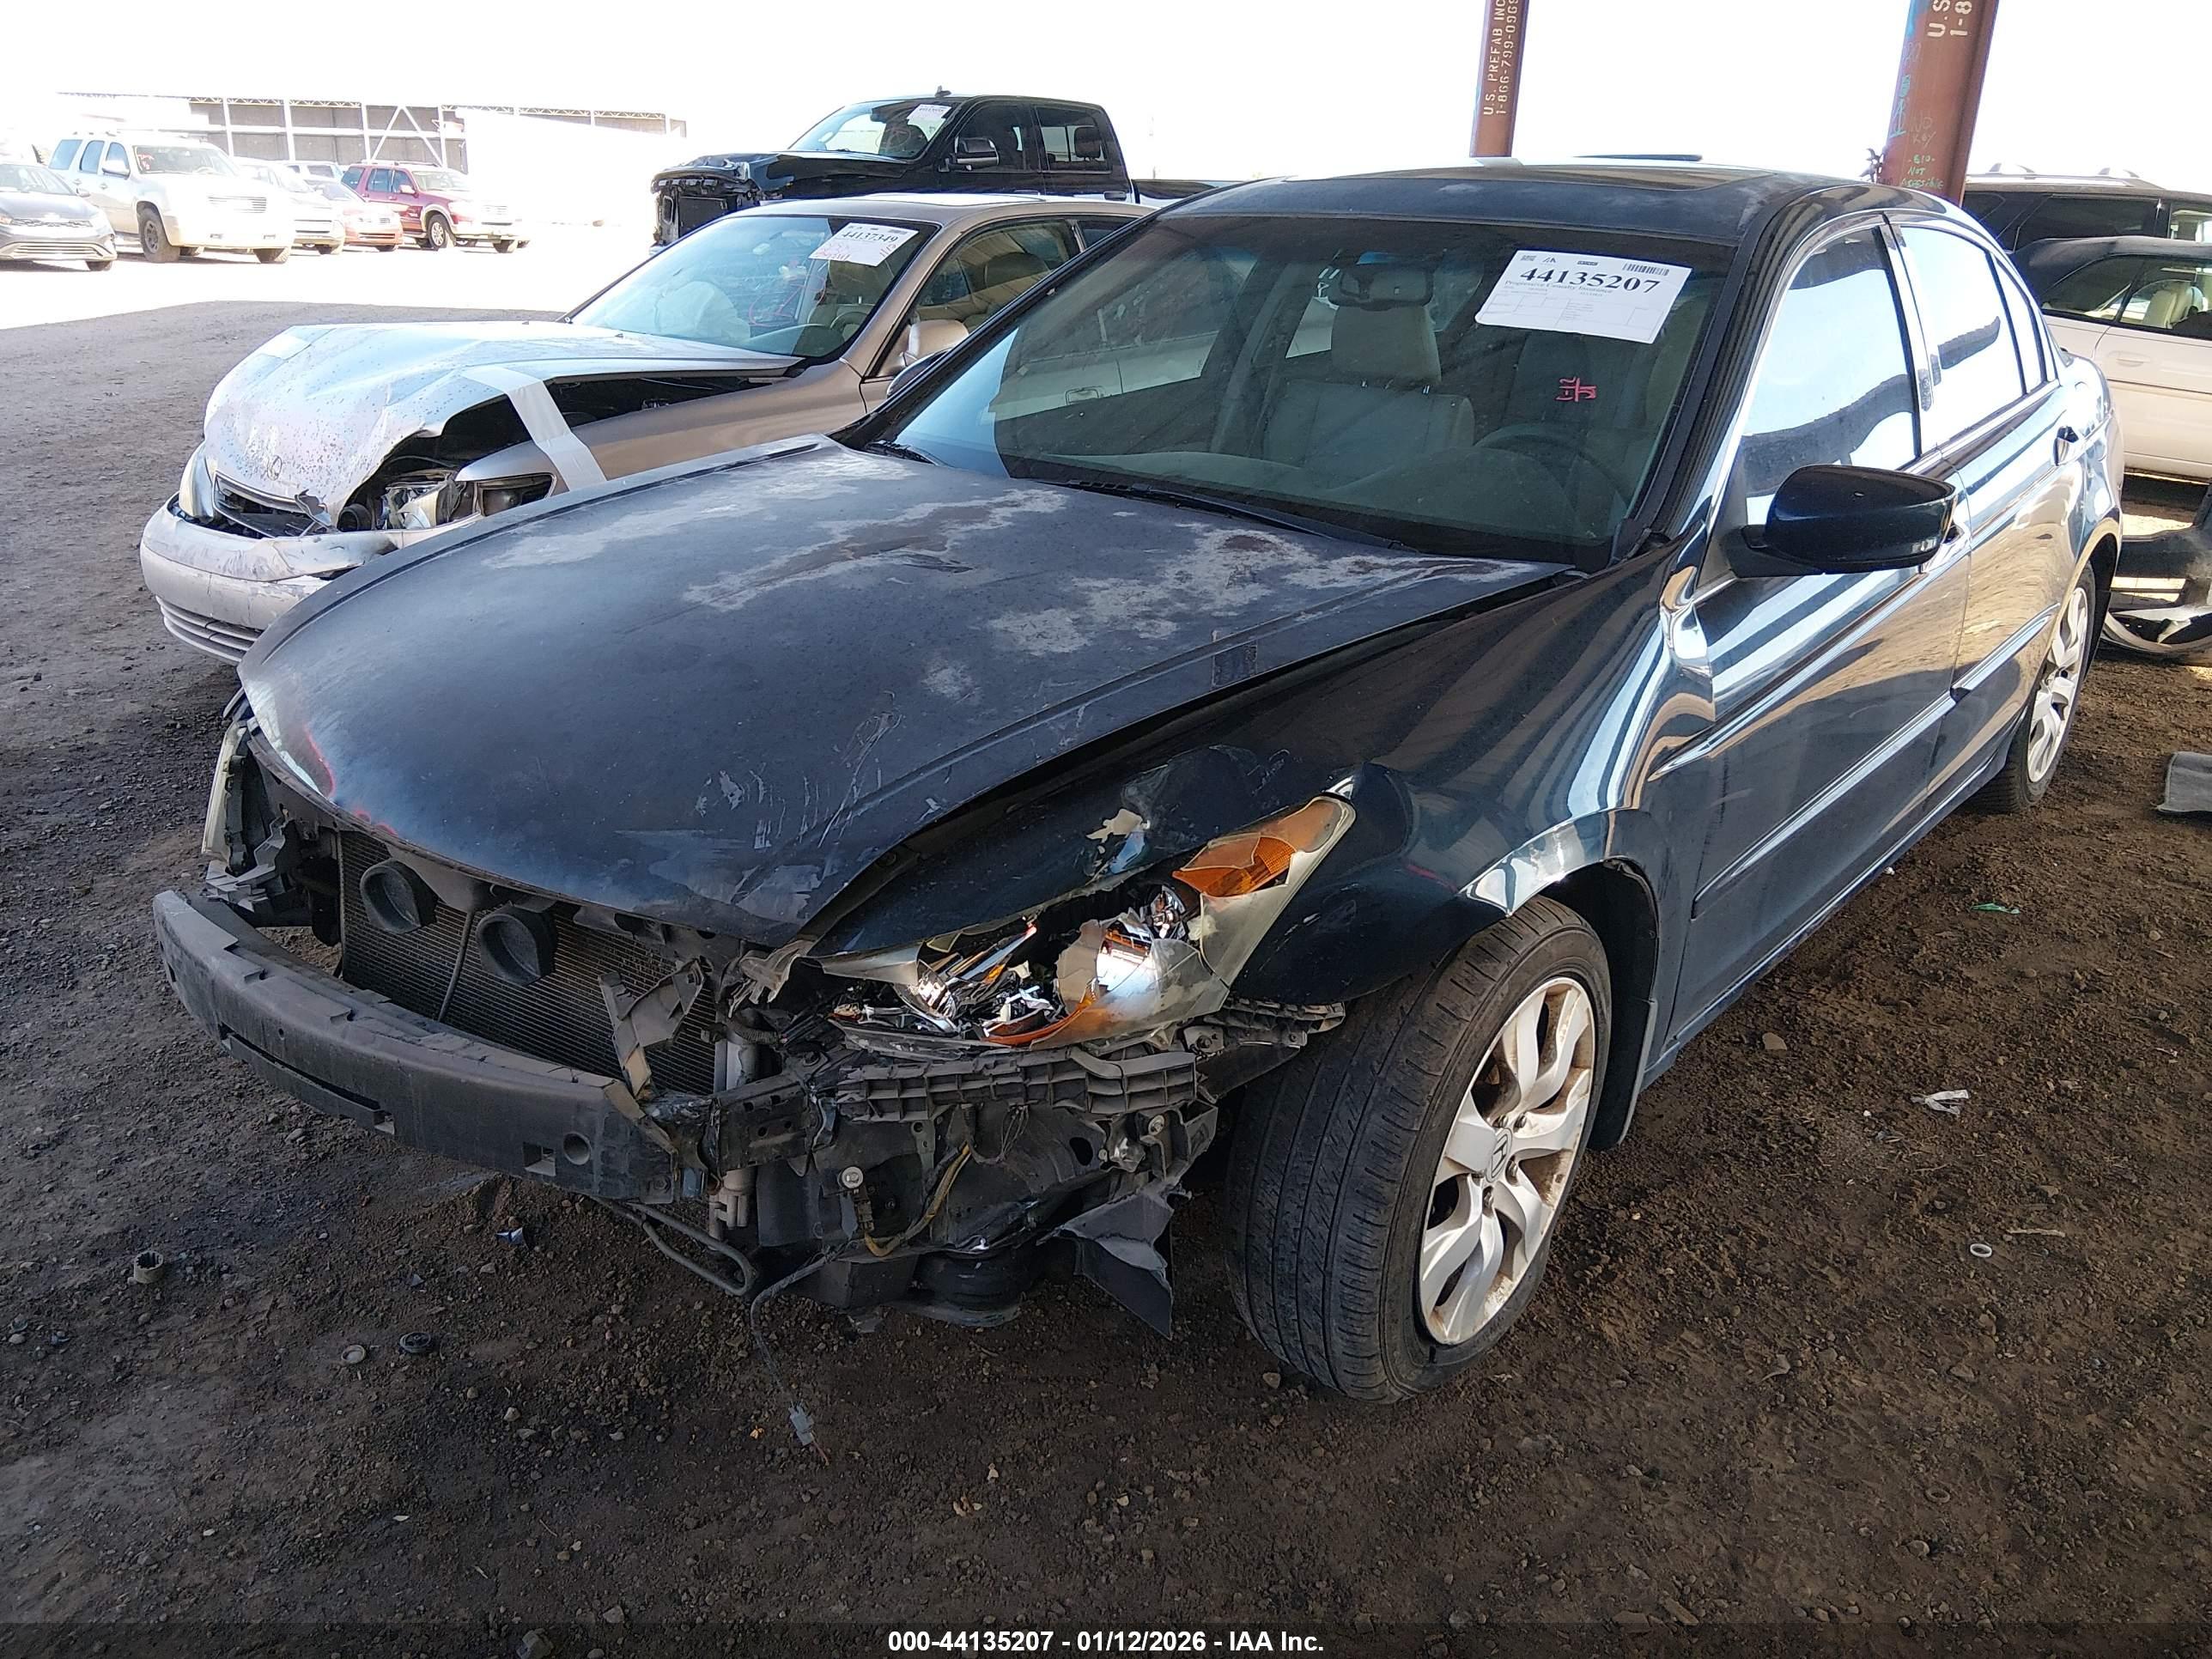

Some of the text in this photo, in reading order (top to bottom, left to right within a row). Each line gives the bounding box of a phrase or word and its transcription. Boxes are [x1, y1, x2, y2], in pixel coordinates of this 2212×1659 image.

[1487, 28, 1504, 82] PREFAB
[842, 230, 899, 243] 44137349
[1519, 267, 1662, 294] 44135207
